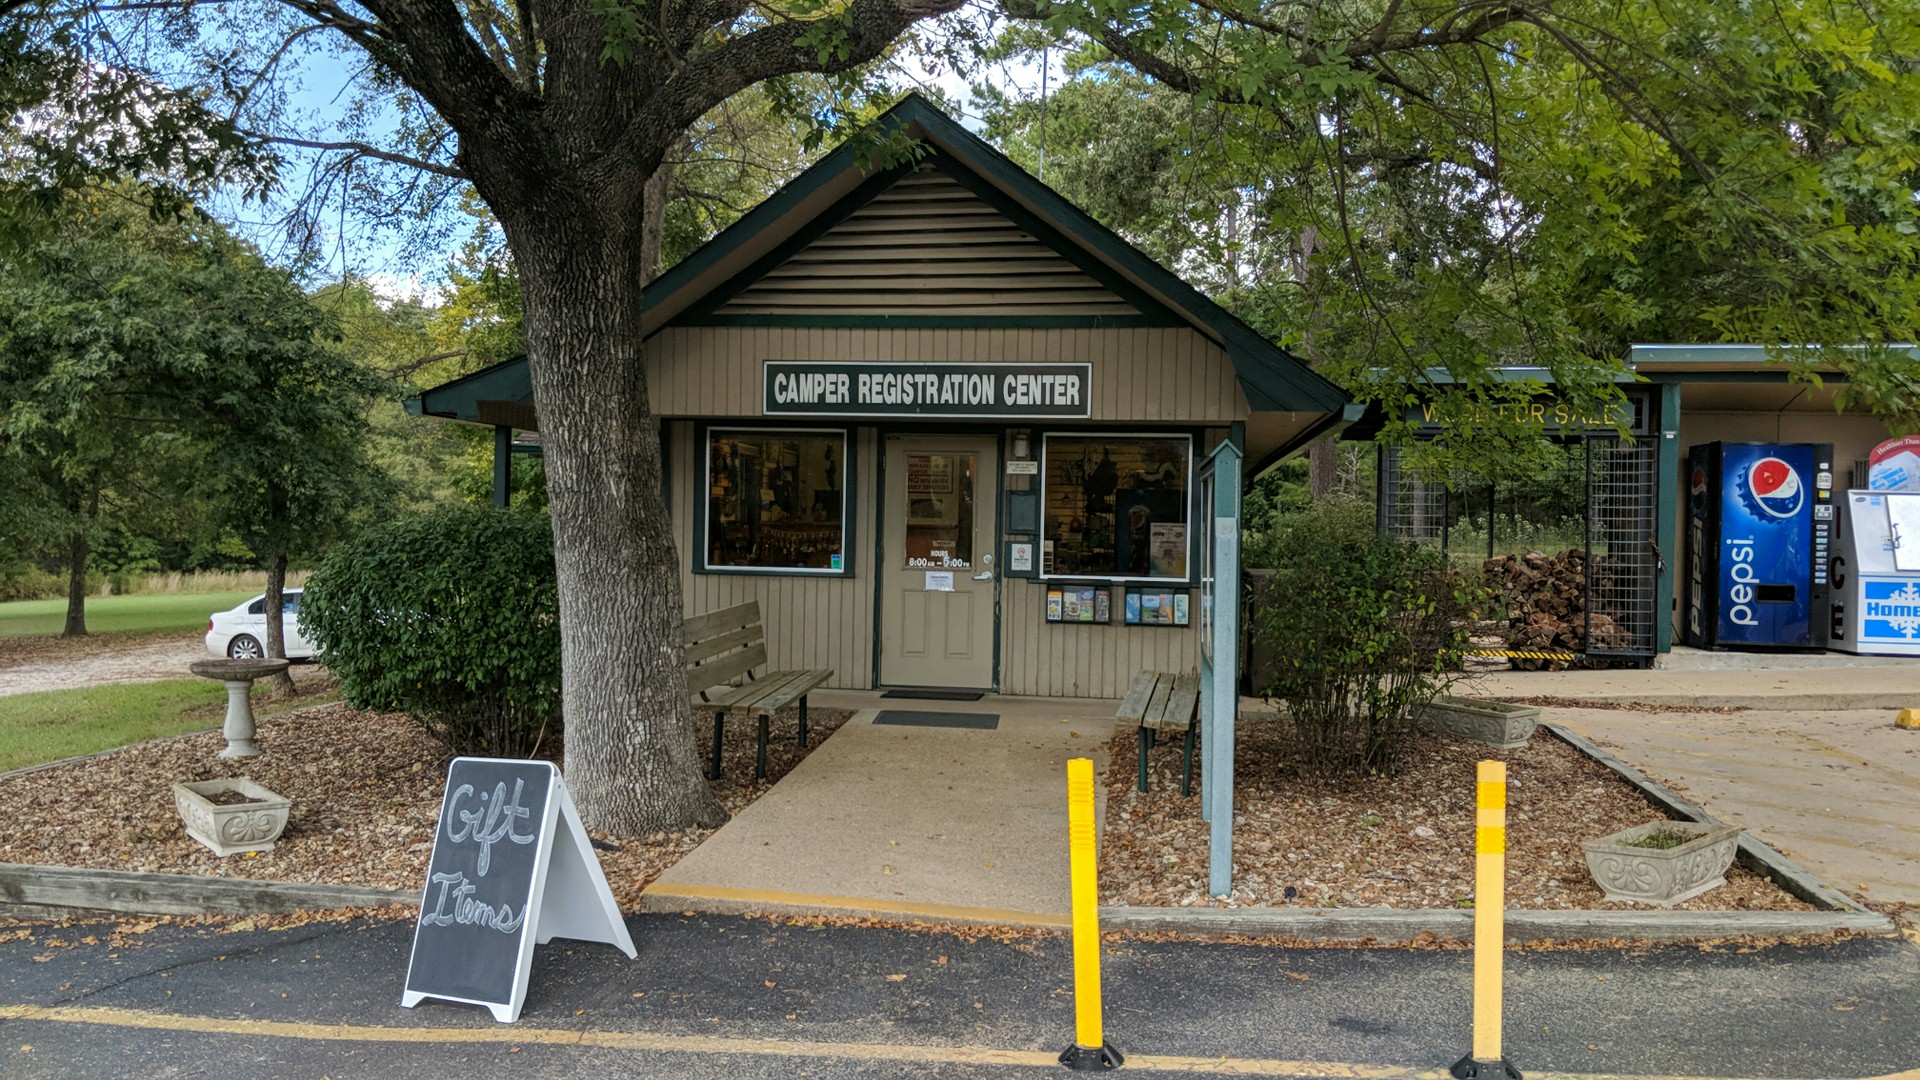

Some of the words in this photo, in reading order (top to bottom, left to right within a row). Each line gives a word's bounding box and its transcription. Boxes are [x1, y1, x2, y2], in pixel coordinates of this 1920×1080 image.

[774, 372, 850, 404] CAMPER
[857, 373, 996, 405] REGISTRATION
[1003, 374, 1080, 406] CENTER
[1691, 516, 1703, 636] PEPSI
[1726, 538, 1760, 625] pepsi
[1867, 602, 1920, 617] Home
[447, 777, 535, 877] Gift
[421, 871, 528, 934] Items
